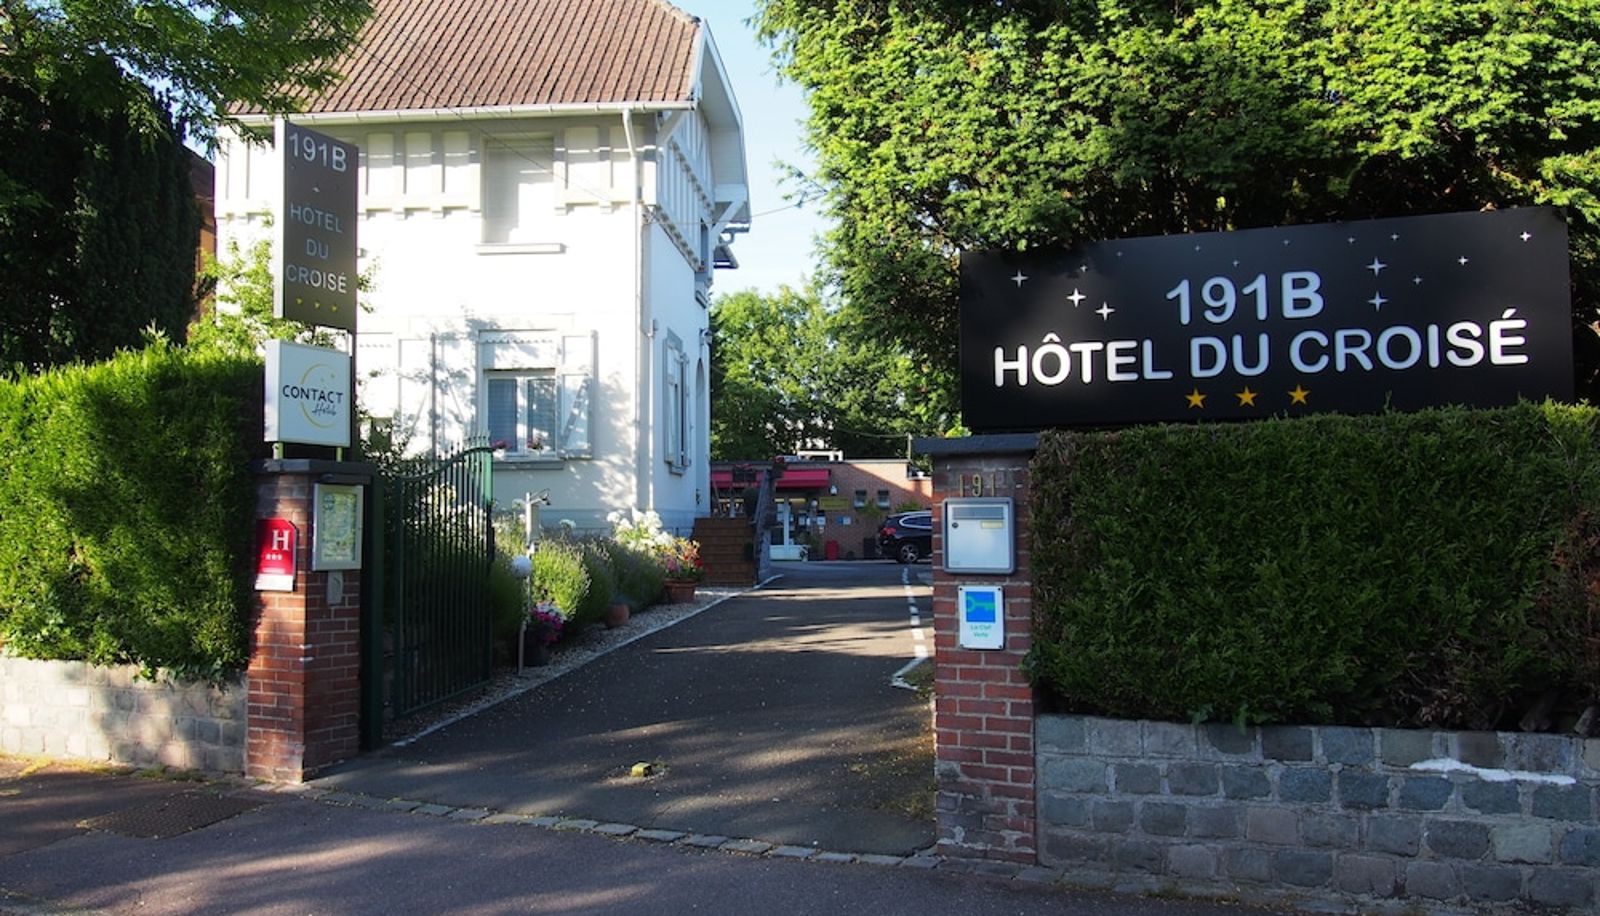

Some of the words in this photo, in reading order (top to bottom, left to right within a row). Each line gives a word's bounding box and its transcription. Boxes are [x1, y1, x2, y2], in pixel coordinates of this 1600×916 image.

[288, 132, 347, 172] 191B
[306, 238, 329, 260] DU
[286, 264, 347, 294] CROISÉ
[1165, 271, 1325, 326] 191B
[994, 332, 1174, 388] HÔTEL
[1189, 332, 1271, 379] DU
[1289, 307, 1530, 374] CROISÉ
[282, 384, 344, 404] CONTACT
[959, 473, 996, 498] 191
[272, 529, 290, 551] H
